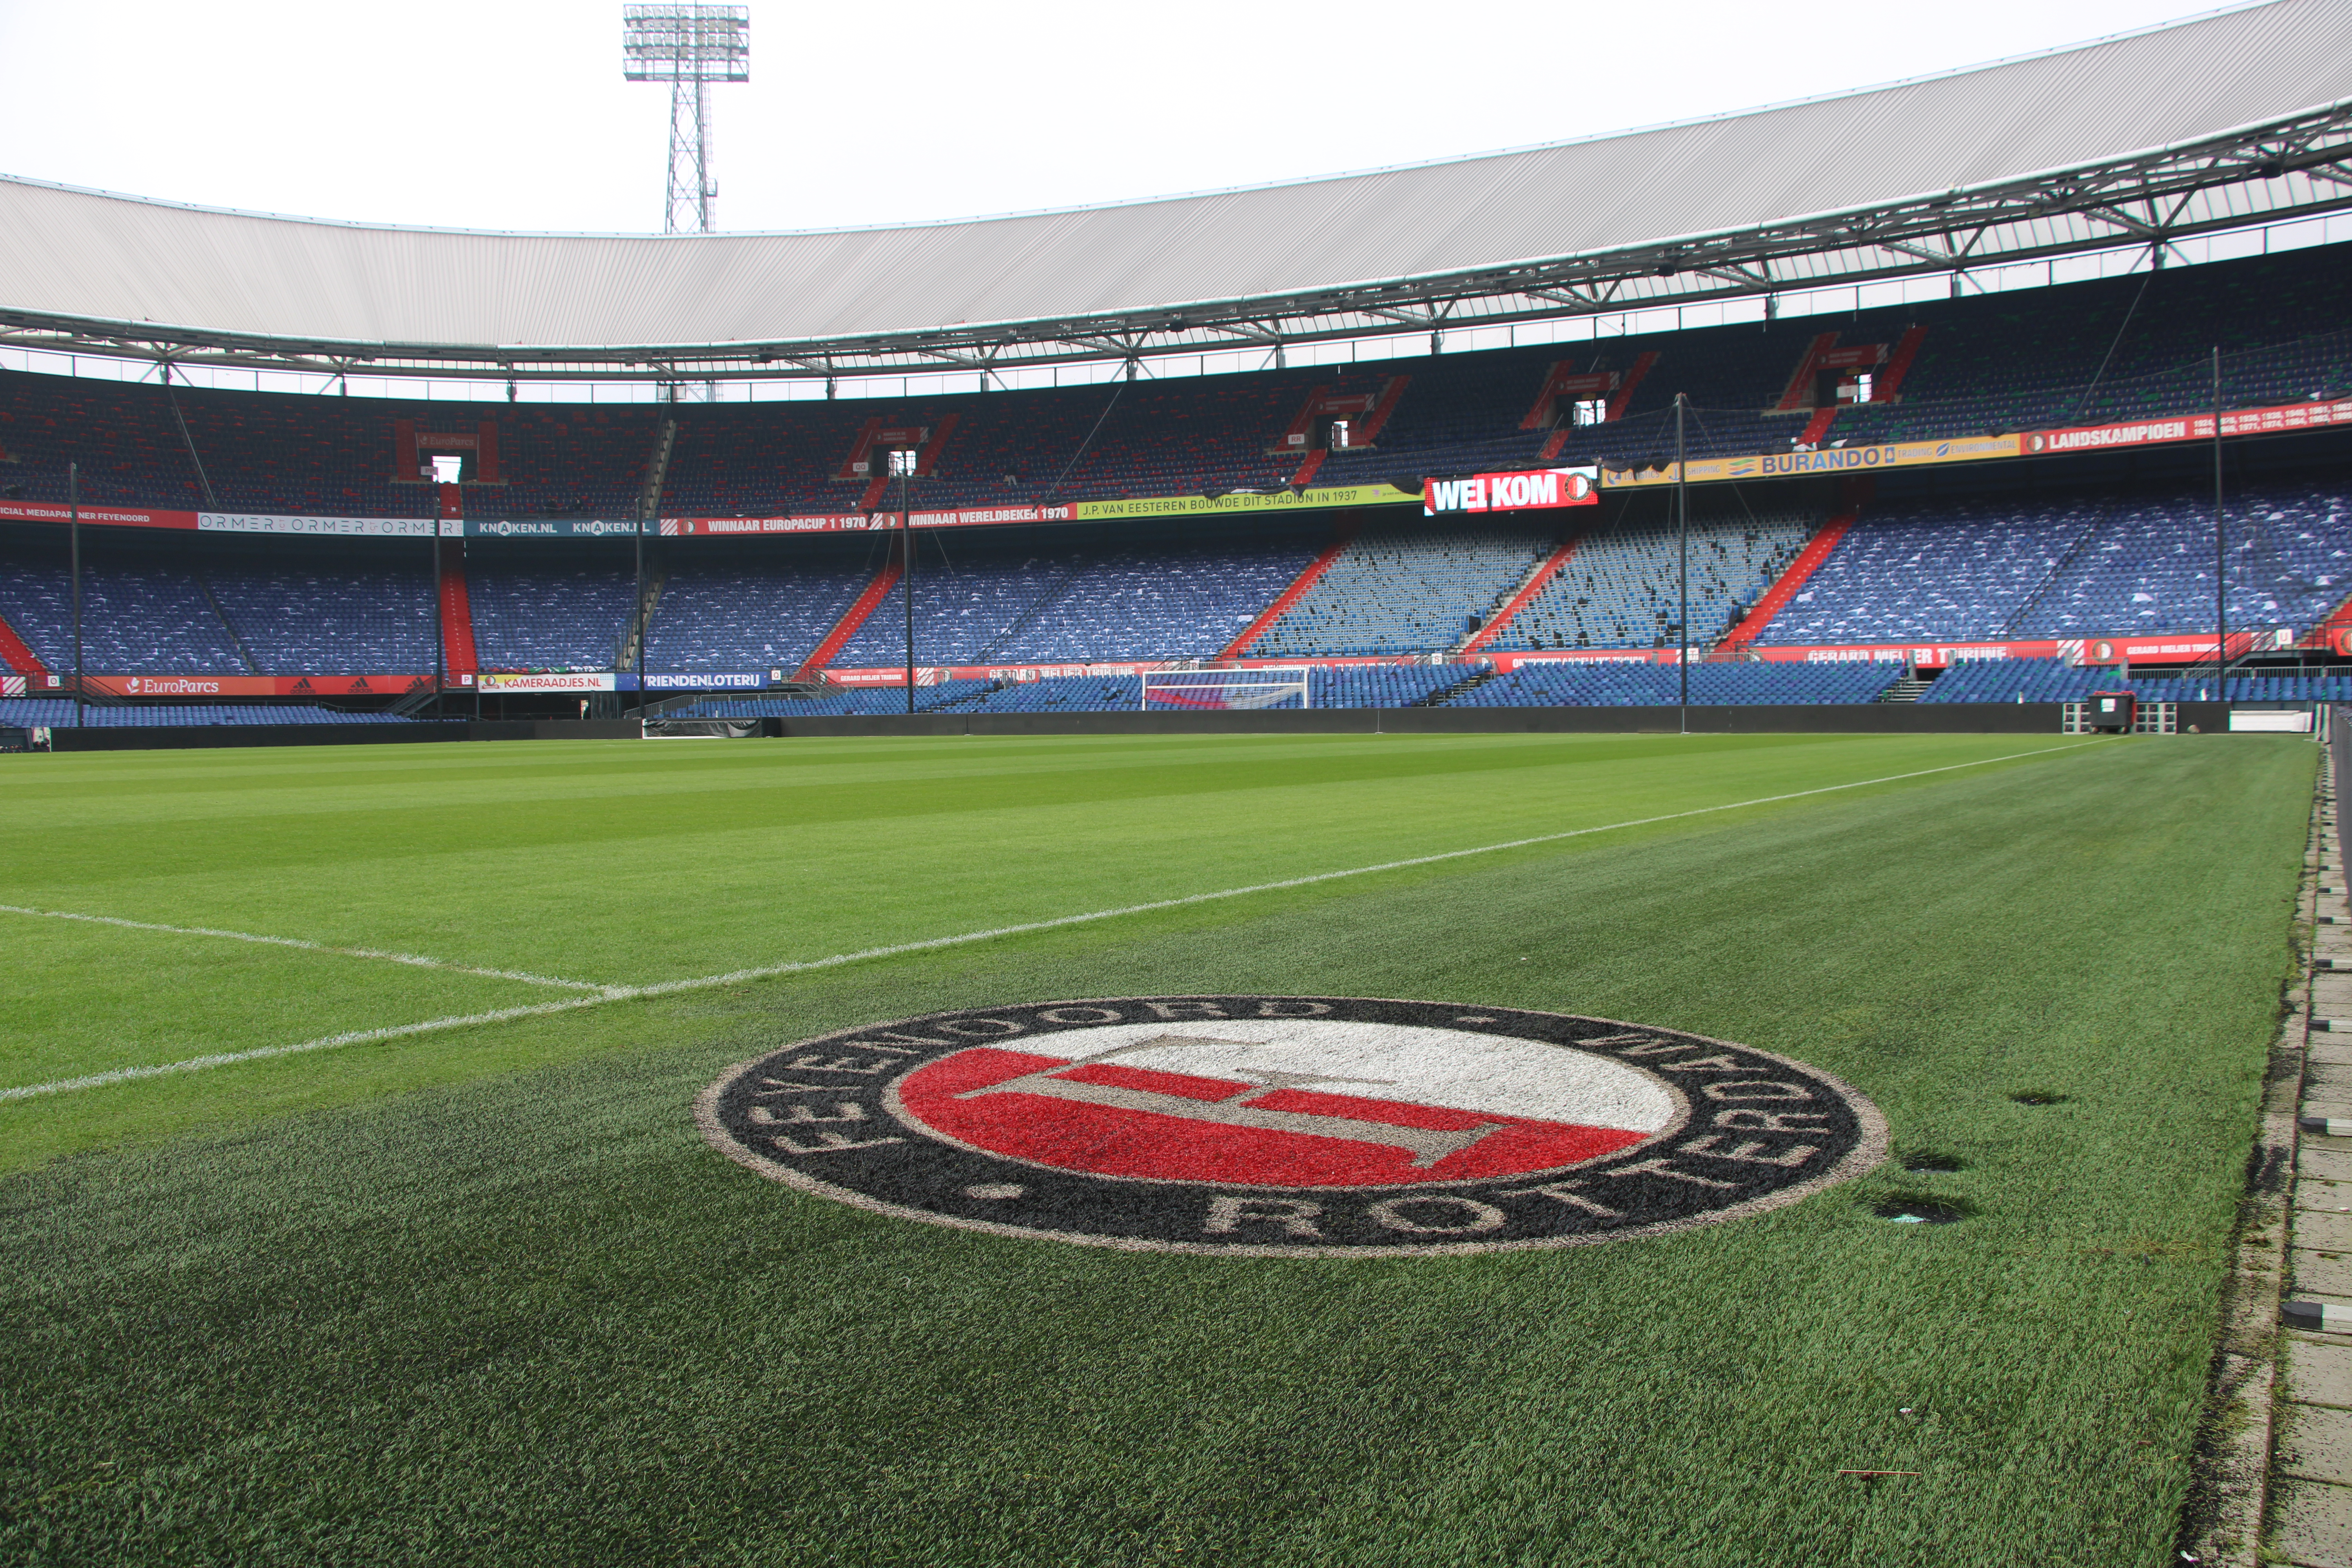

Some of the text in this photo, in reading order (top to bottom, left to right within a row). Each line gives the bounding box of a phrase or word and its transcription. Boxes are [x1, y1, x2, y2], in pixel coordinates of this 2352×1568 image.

[430, 436, 474, 446] EuroParcs
[2049, 421, 2185, 450] LANDSKAMPIOEN
[1898, 440, 2016, 458] TRADING ENVIRONMENTAL
[1762, 447, 1880, 474] BURANDO
[1687, 465, 1720, 475] SHIPPING
[1432, 474, 1557, 511] WELKOM
[1083, 490, 1357, 515] J.P. VAN EESTEREN BOUWDE DIT STADION IN 1937
[0, 507, 150, 522] ICIAL MEDIAPARNER FEYENOORD
[909, 507, 1068, 526] WINNAAR WERELDBEKER 1970
[200, 515, 274, 530] ORMER
[292, 519, 364, 533] ORMER
[479, 522, 557, 534] KNAKEN.NL
[708, 516, 866, 532] WINNAAR EUROPACUP 1 1970
[2279, 632, 2287, 641] U
[144, 679, 219, 693] EuroParcs
[505, 677, 601, 688] KAMERAADJES.NL
[747, 1001, 1331, 1156] FEYENOORD
[1203, 1032, 1833, 1236] ROTTERDAM
